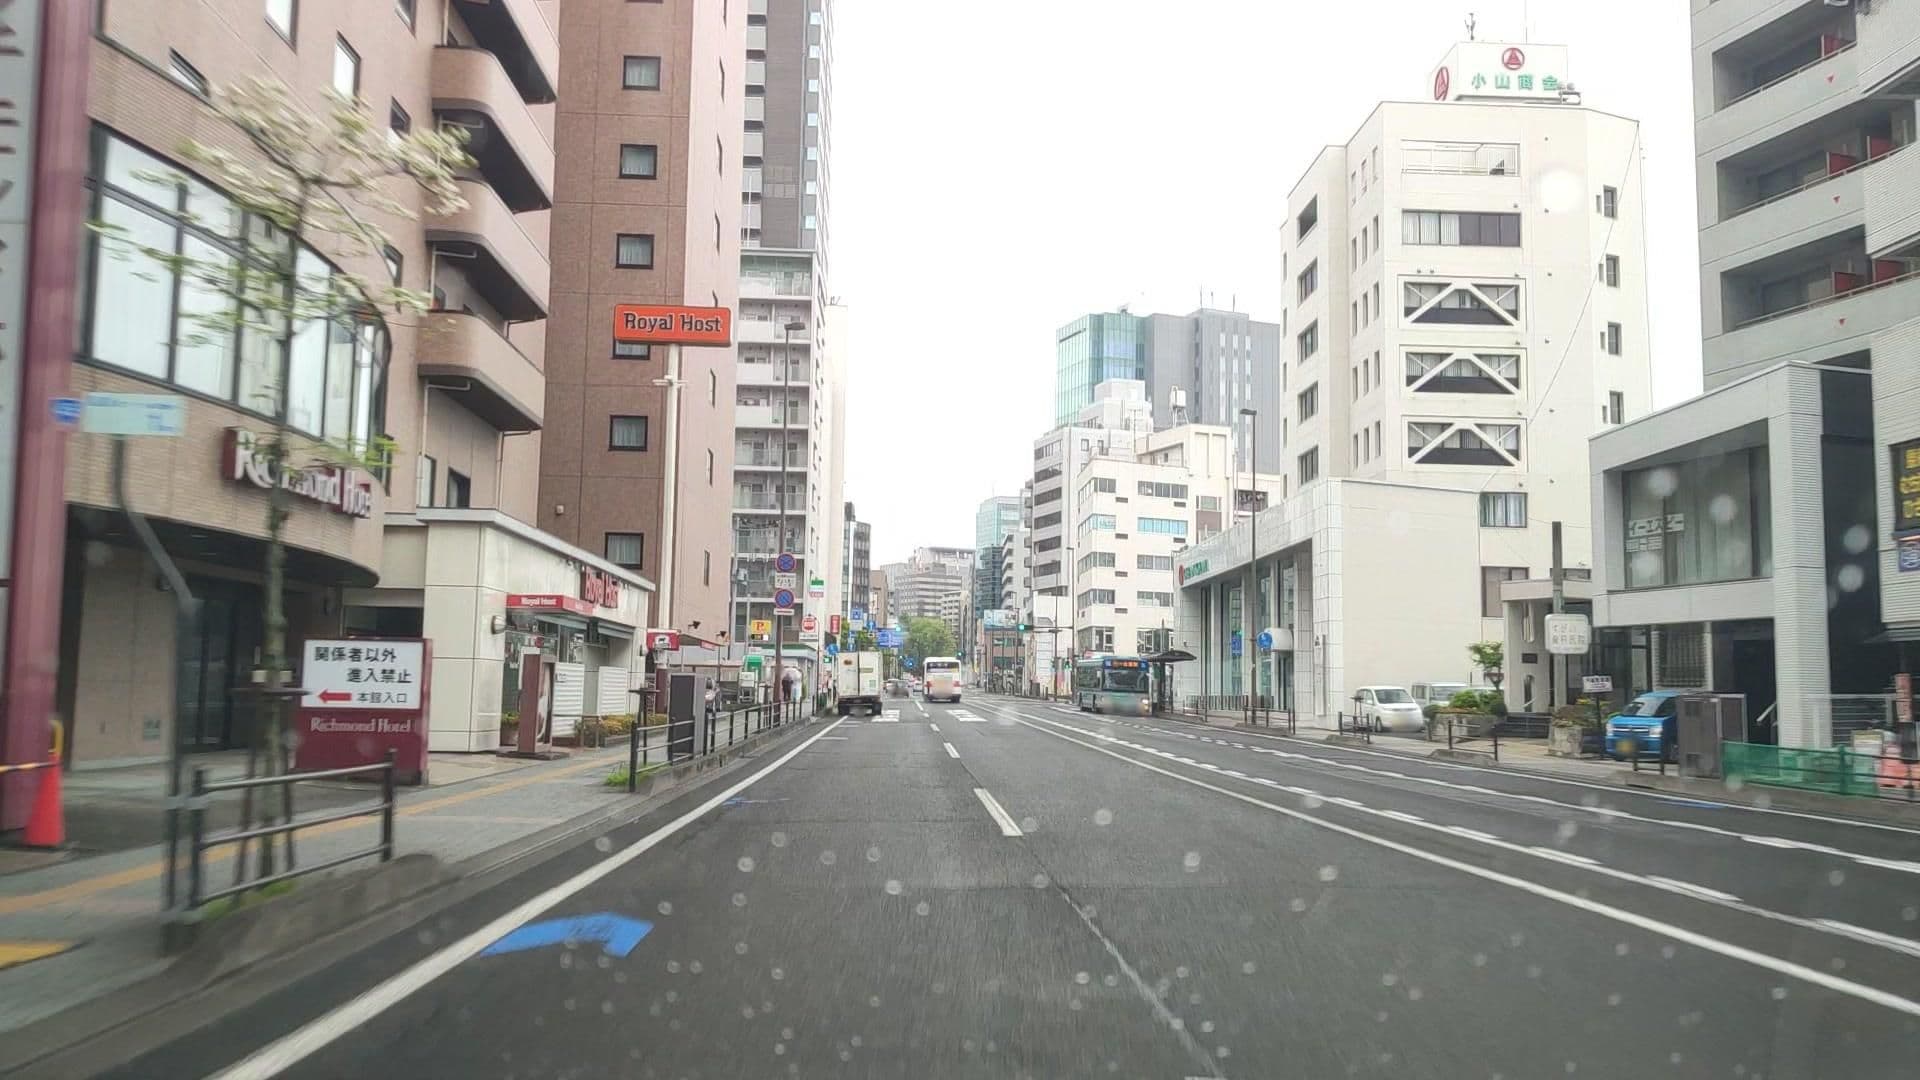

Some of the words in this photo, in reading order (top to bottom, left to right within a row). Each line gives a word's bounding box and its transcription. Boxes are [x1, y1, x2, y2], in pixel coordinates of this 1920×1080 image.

[624, 313, 673, 332] Royal
[680, 314, 721, 332] Host
[314, 647, 397, 662] 関係者以外
[346, 668, 412, 683] 進入禁止
[357, 692, 408, 704] 本館入口
[311, 717, 376, 732] Richmond
[378, 718, 411, 732] Hotel
